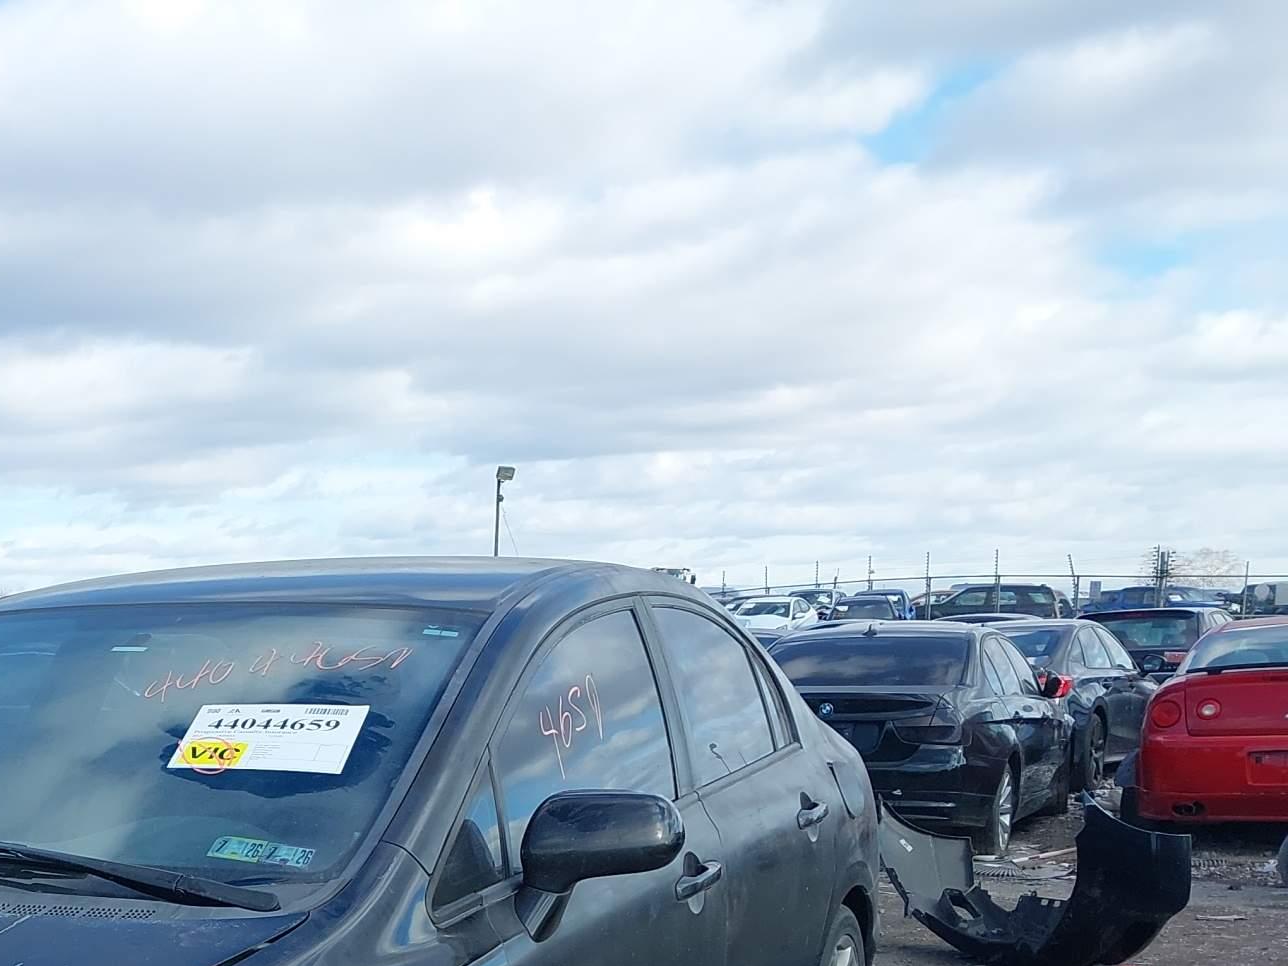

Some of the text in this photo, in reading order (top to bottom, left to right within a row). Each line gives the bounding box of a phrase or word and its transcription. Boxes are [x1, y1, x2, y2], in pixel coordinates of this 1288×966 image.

[207, 717, 342, 732] 44044659
[190, 745, 241, 761] VIC
[215, 839, 264, 859] 7 26
[266, 846, 314, 865] 7 26
